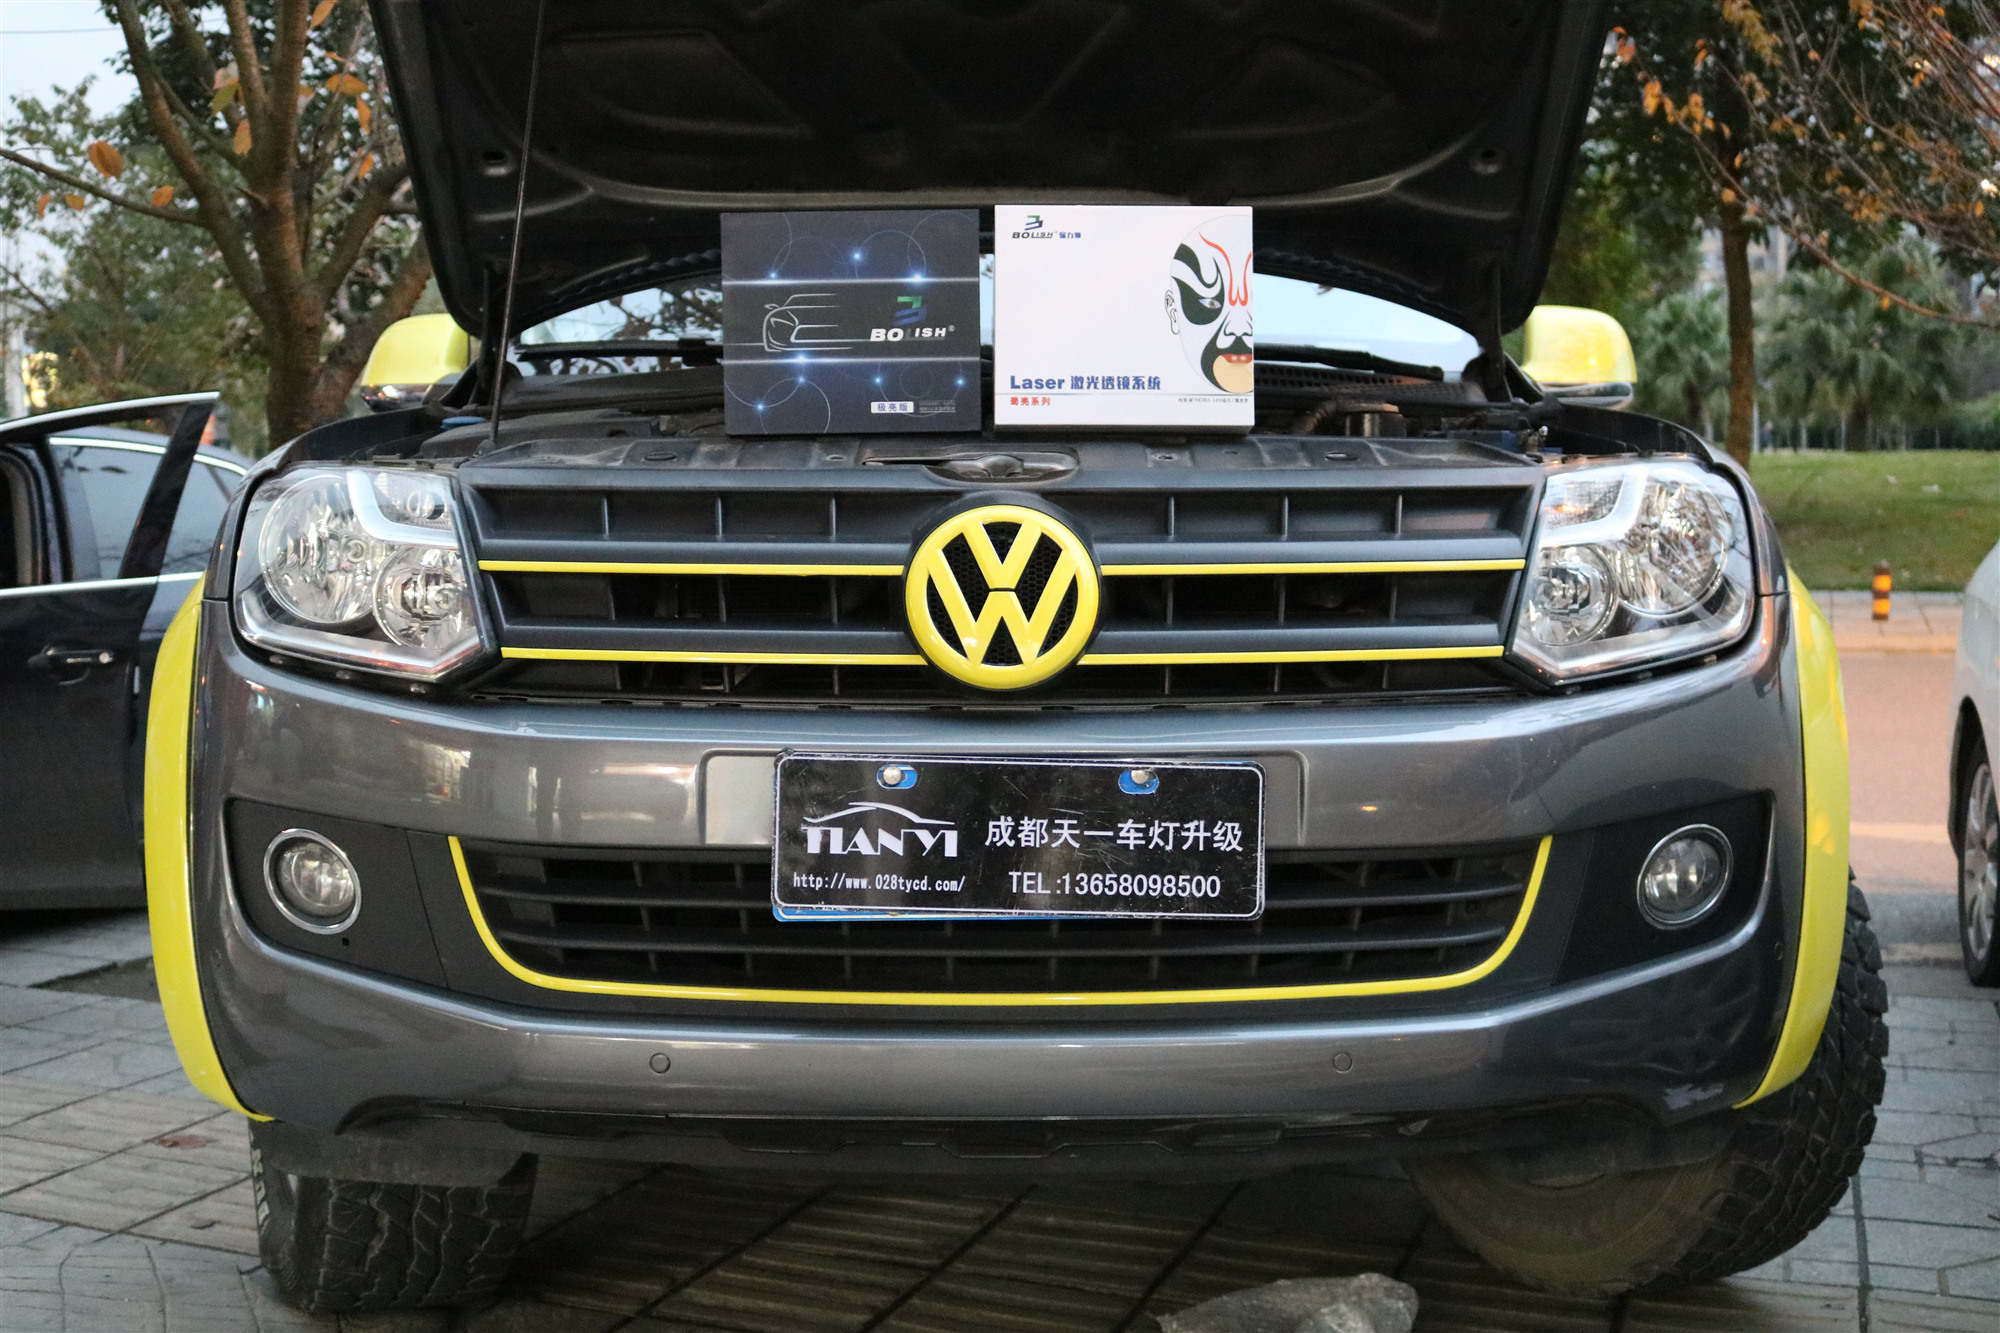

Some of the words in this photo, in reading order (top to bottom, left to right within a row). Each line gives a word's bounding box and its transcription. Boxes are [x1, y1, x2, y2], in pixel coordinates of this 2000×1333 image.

[1012, 231, 1053, 239] BOLISH
[1010, 375, 1065, 390] Laser
[1070, 375, 1161, 390] 激光透镜系统
[802, 825, 958, 858] TIANYI
[984, 816, 1244, 853] 成都天一车灯升级
